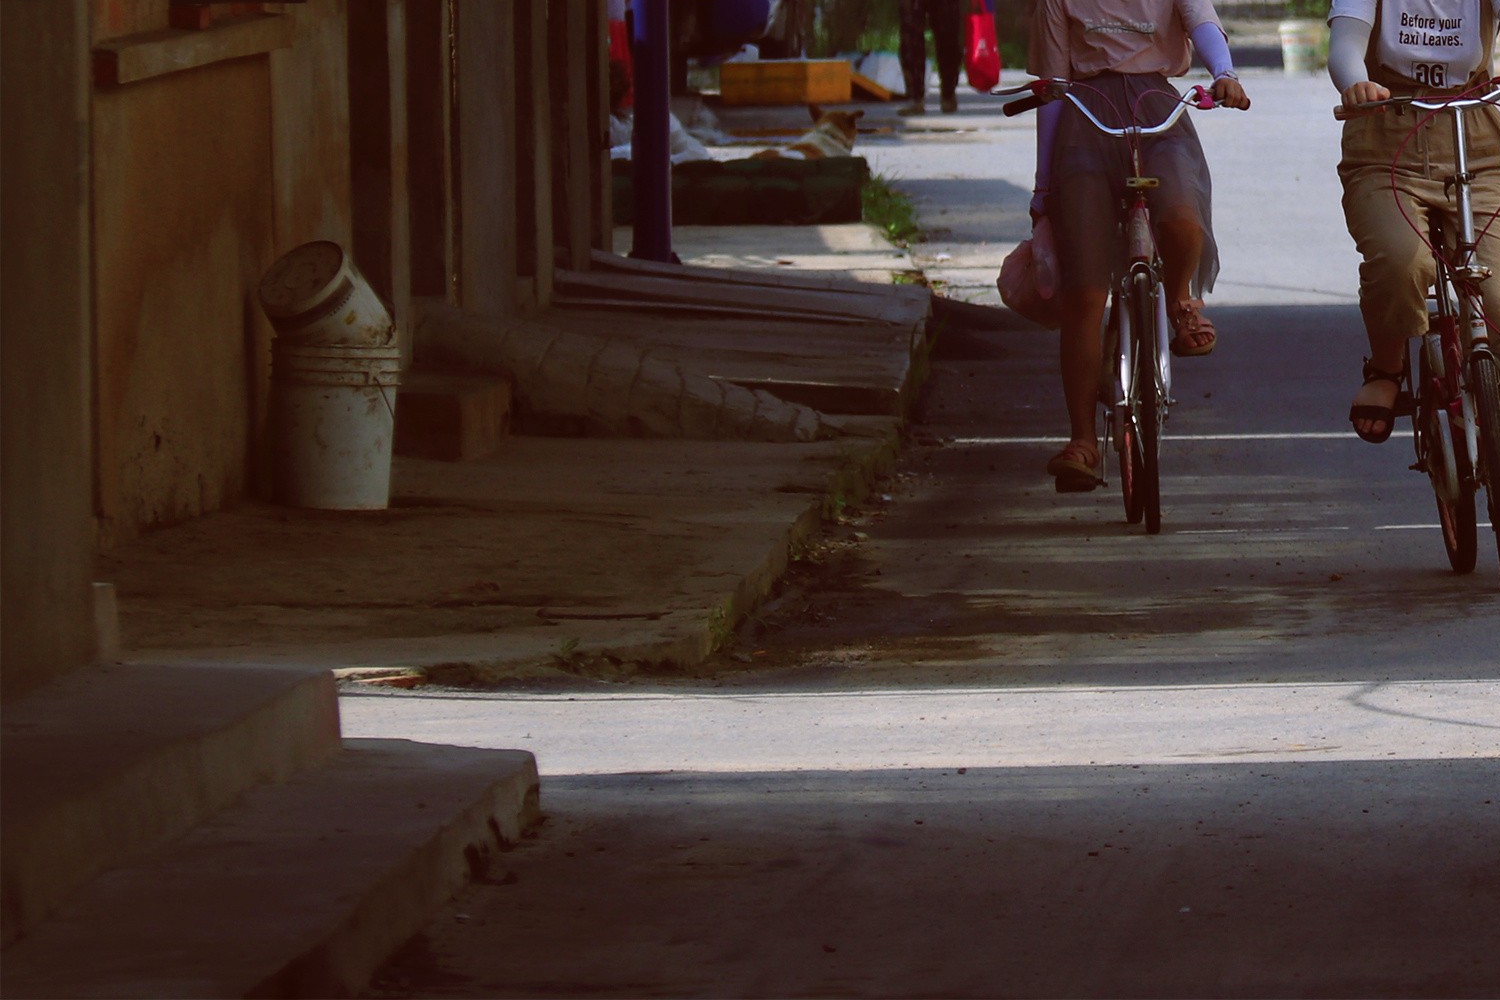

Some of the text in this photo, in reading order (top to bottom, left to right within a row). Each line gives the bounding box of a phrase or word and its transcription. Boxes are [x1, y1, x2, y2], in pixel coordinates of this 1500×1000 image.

[1400, 12, 1463, 32] Before your
[1399, 30, 1464, 46] taxi Leaves.
